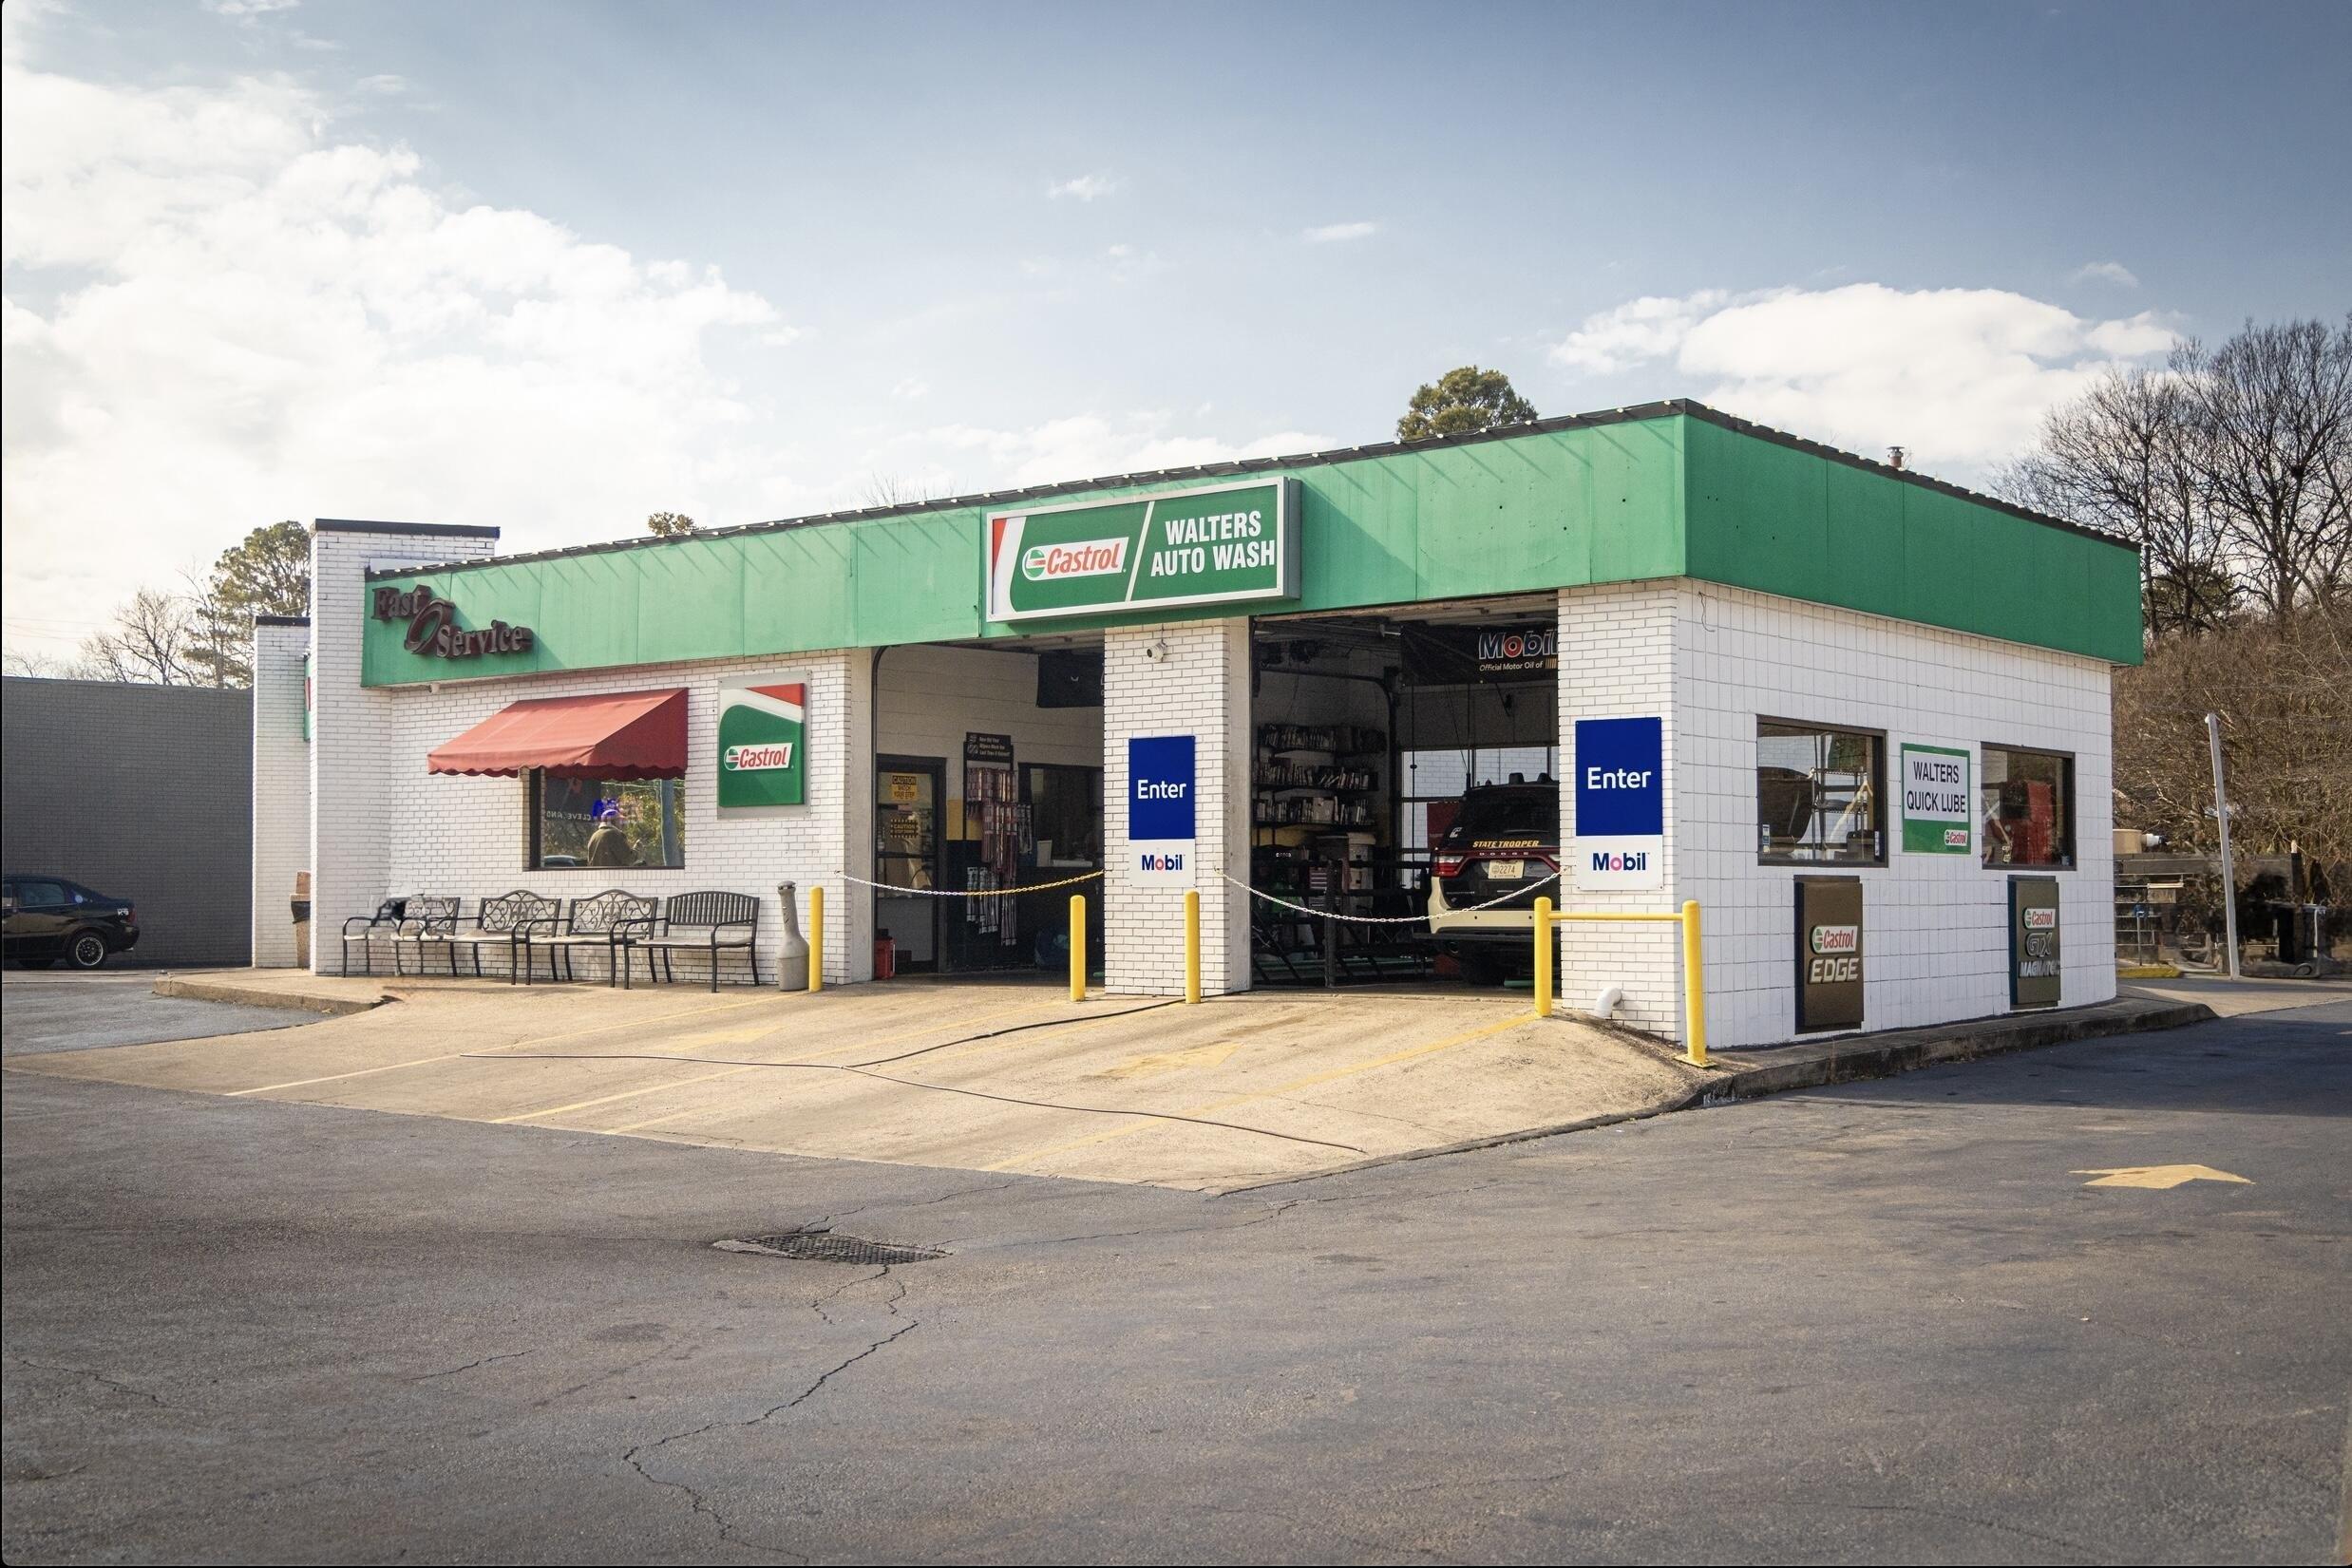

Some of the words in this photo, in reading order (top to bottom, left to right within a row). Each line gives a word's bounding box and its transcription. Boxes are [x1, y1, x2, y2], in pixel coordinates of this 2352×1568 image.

[1166, 510, 1261, 545] WALTERS
[1047, 542, 1121, 576] Castrol
[1150, 547, 1205, 577] AUTO
[1213, 539, 1275, 571] WASH
[371, 585, 431, 622] Fast
[436, 619, 533, 659] Service
[1479, 629, 1558, 660] Mobil
[1524, 661, 1534, 670] Oil
[739, 746, 787, 768] Castrol
[1587, 767, 1652, 789] Enter
[1913, 761, 1960, 784] WALTERS
[1138, 780, 1186, 799] Enter
[1906, 790, 1939, 811] QUICK
[1942, 793, 1966, 813] LUBE
[1499, 840, 1540, 848] TROOPER
[1949, 831, 1967, 844] Castrol
[1142, 854, 1183, 871] Mobil
[1499, 865, 1515, 874] 2274
[1592, 852, 1646, 871] Mobil
[2032, 911, 2053, 927] Castrol
[1823, 930, 1854, 949] Castrol
[2026, 932, 2053, 957] GTX
[1810, 957, 1859, 983] EDGE
